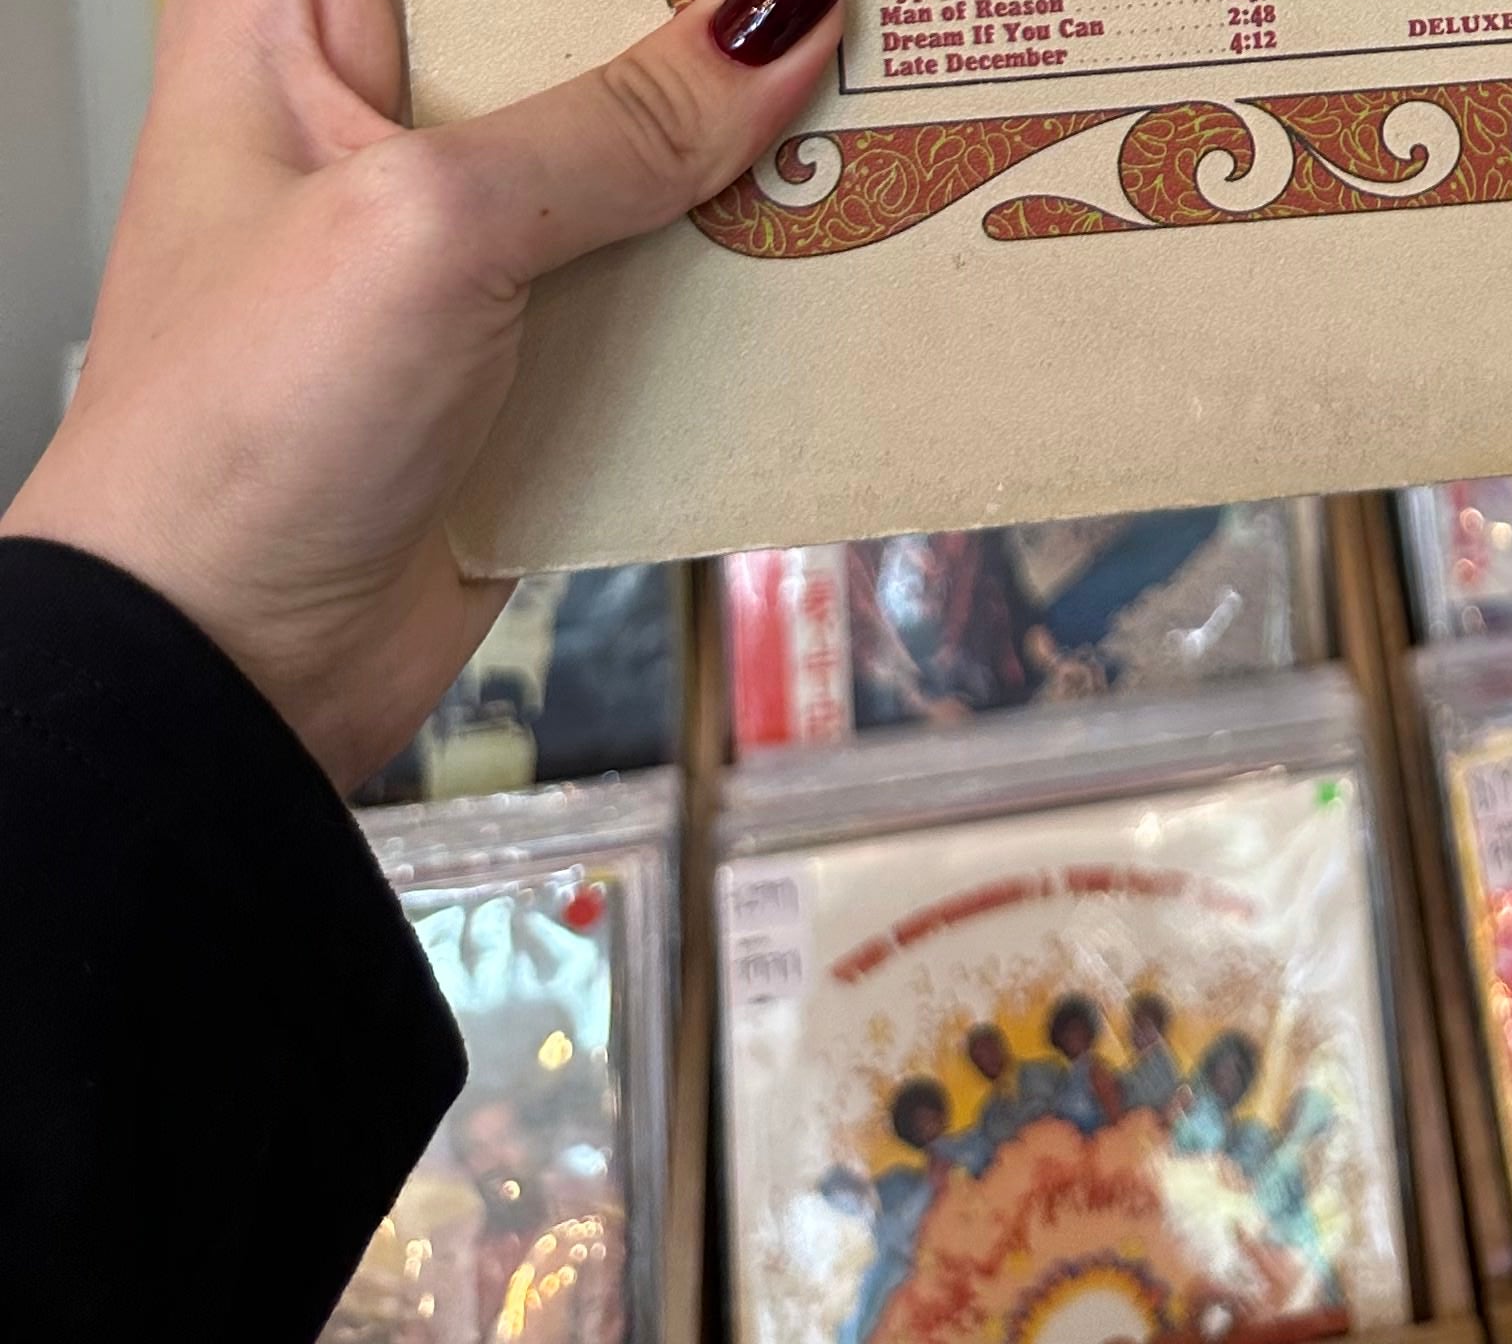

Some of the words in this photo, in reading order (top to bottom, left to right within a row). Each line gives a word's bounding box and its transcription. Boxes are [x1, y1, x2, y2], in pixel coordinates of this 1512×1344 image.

[881, 6, 933, 27] Man
[941, 1, 967, 22] of
[883, 28, 966, 52] Dream
[971, 23, 996, 45] If
[1003, 20, 1053, 43] You
[1058, 16, 1105, 38] Can
[1228, 4, 1278, 28] 2:48
[884, 56, 939, 78] Late
[944, 46, 1067, 75] December
[1228, 30, 1279, 55] 4:12
